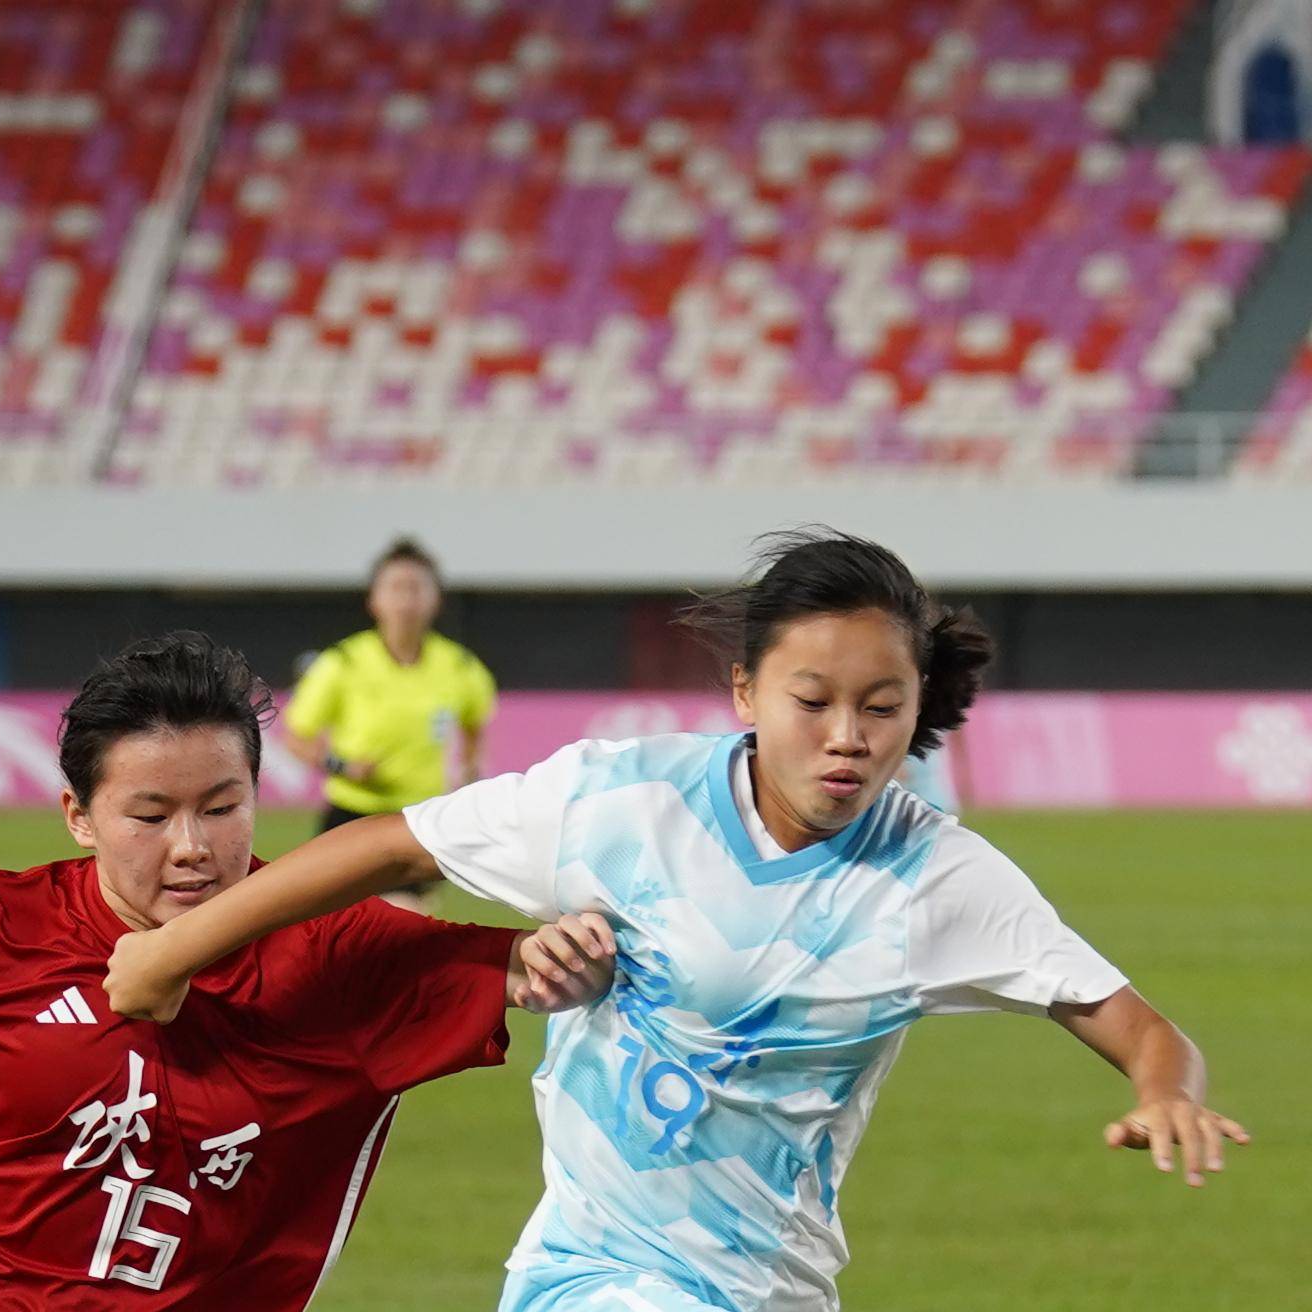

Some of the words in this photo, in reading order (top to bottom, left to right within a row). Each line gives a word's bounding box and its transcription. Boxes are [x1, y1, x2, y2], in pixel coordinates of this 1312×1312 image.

[63, 1050, 261, 1191] 陕西
[614, 1034, 705, 1156] 19
[89, 1175, 191, 1291] 15
